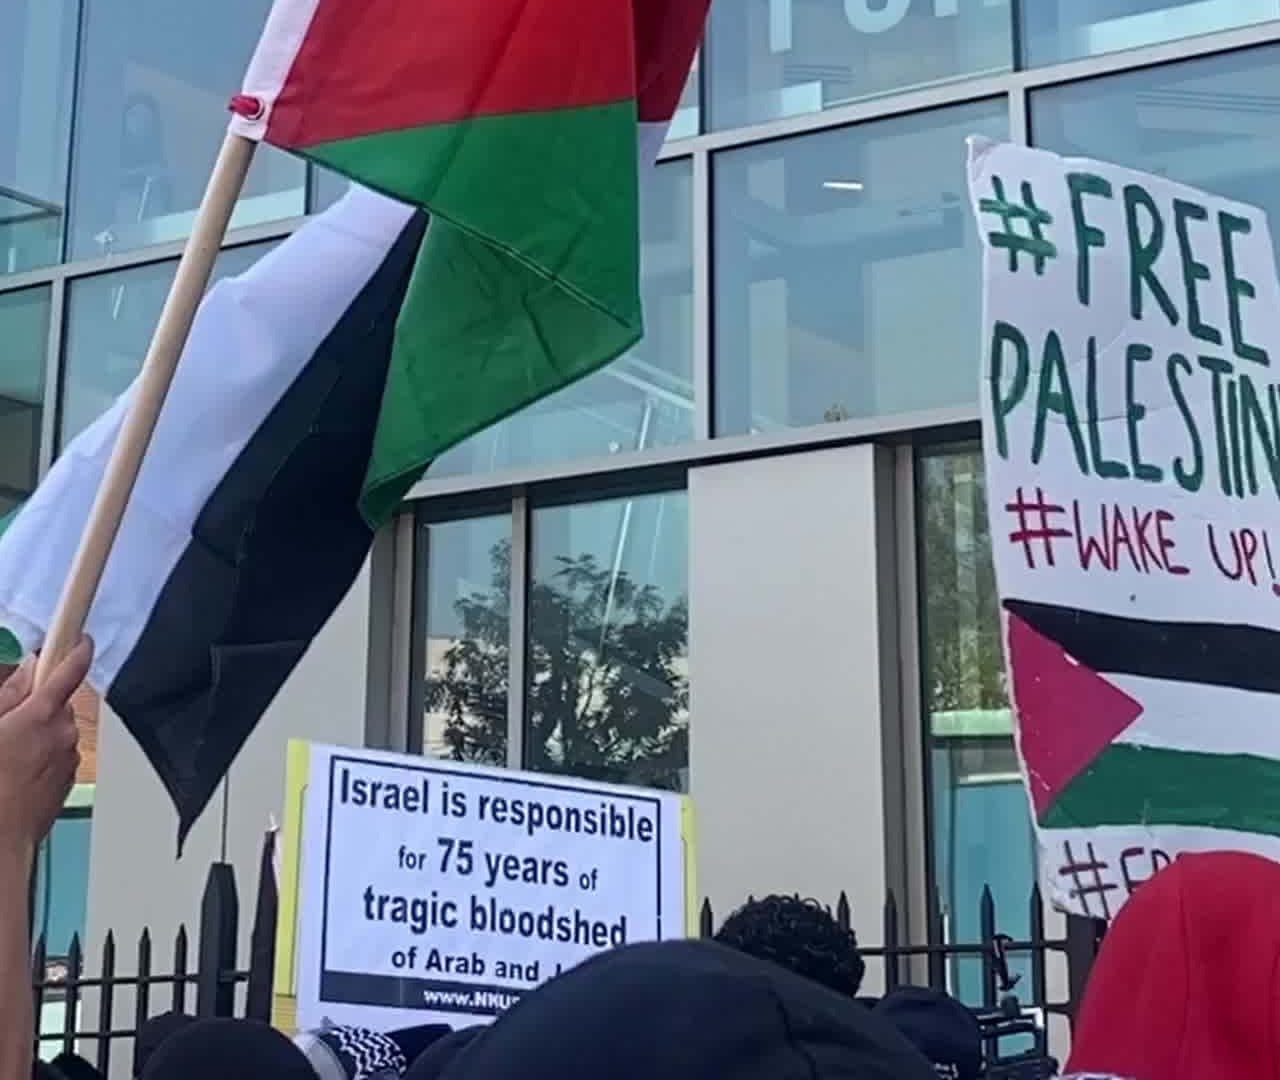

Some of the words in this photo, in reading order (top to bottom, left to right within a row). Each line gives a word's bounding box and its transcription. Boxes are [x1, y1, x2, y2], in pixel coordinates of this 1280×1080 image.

[979, 172, 1269, 366] #FREE
[1005, 487, 1190, 575] #WAKE
[340, 768, 429, 815] Israel
[441, 781, 467, 818] is
[478, 794, 654, 842] responsible
[398, 844, 427, 871] for
[437, 837, 474, 876] 75
[484, 850, 569, 889] years
[579, 867, 598, 891] of
[363, 886, 458, 935] tragic
[470, 894, 627, 948] bloodshed
[391, 946, 417, 970] of
[425, 948, 485, 976] Arab
[495, 960, 539, 982] and
